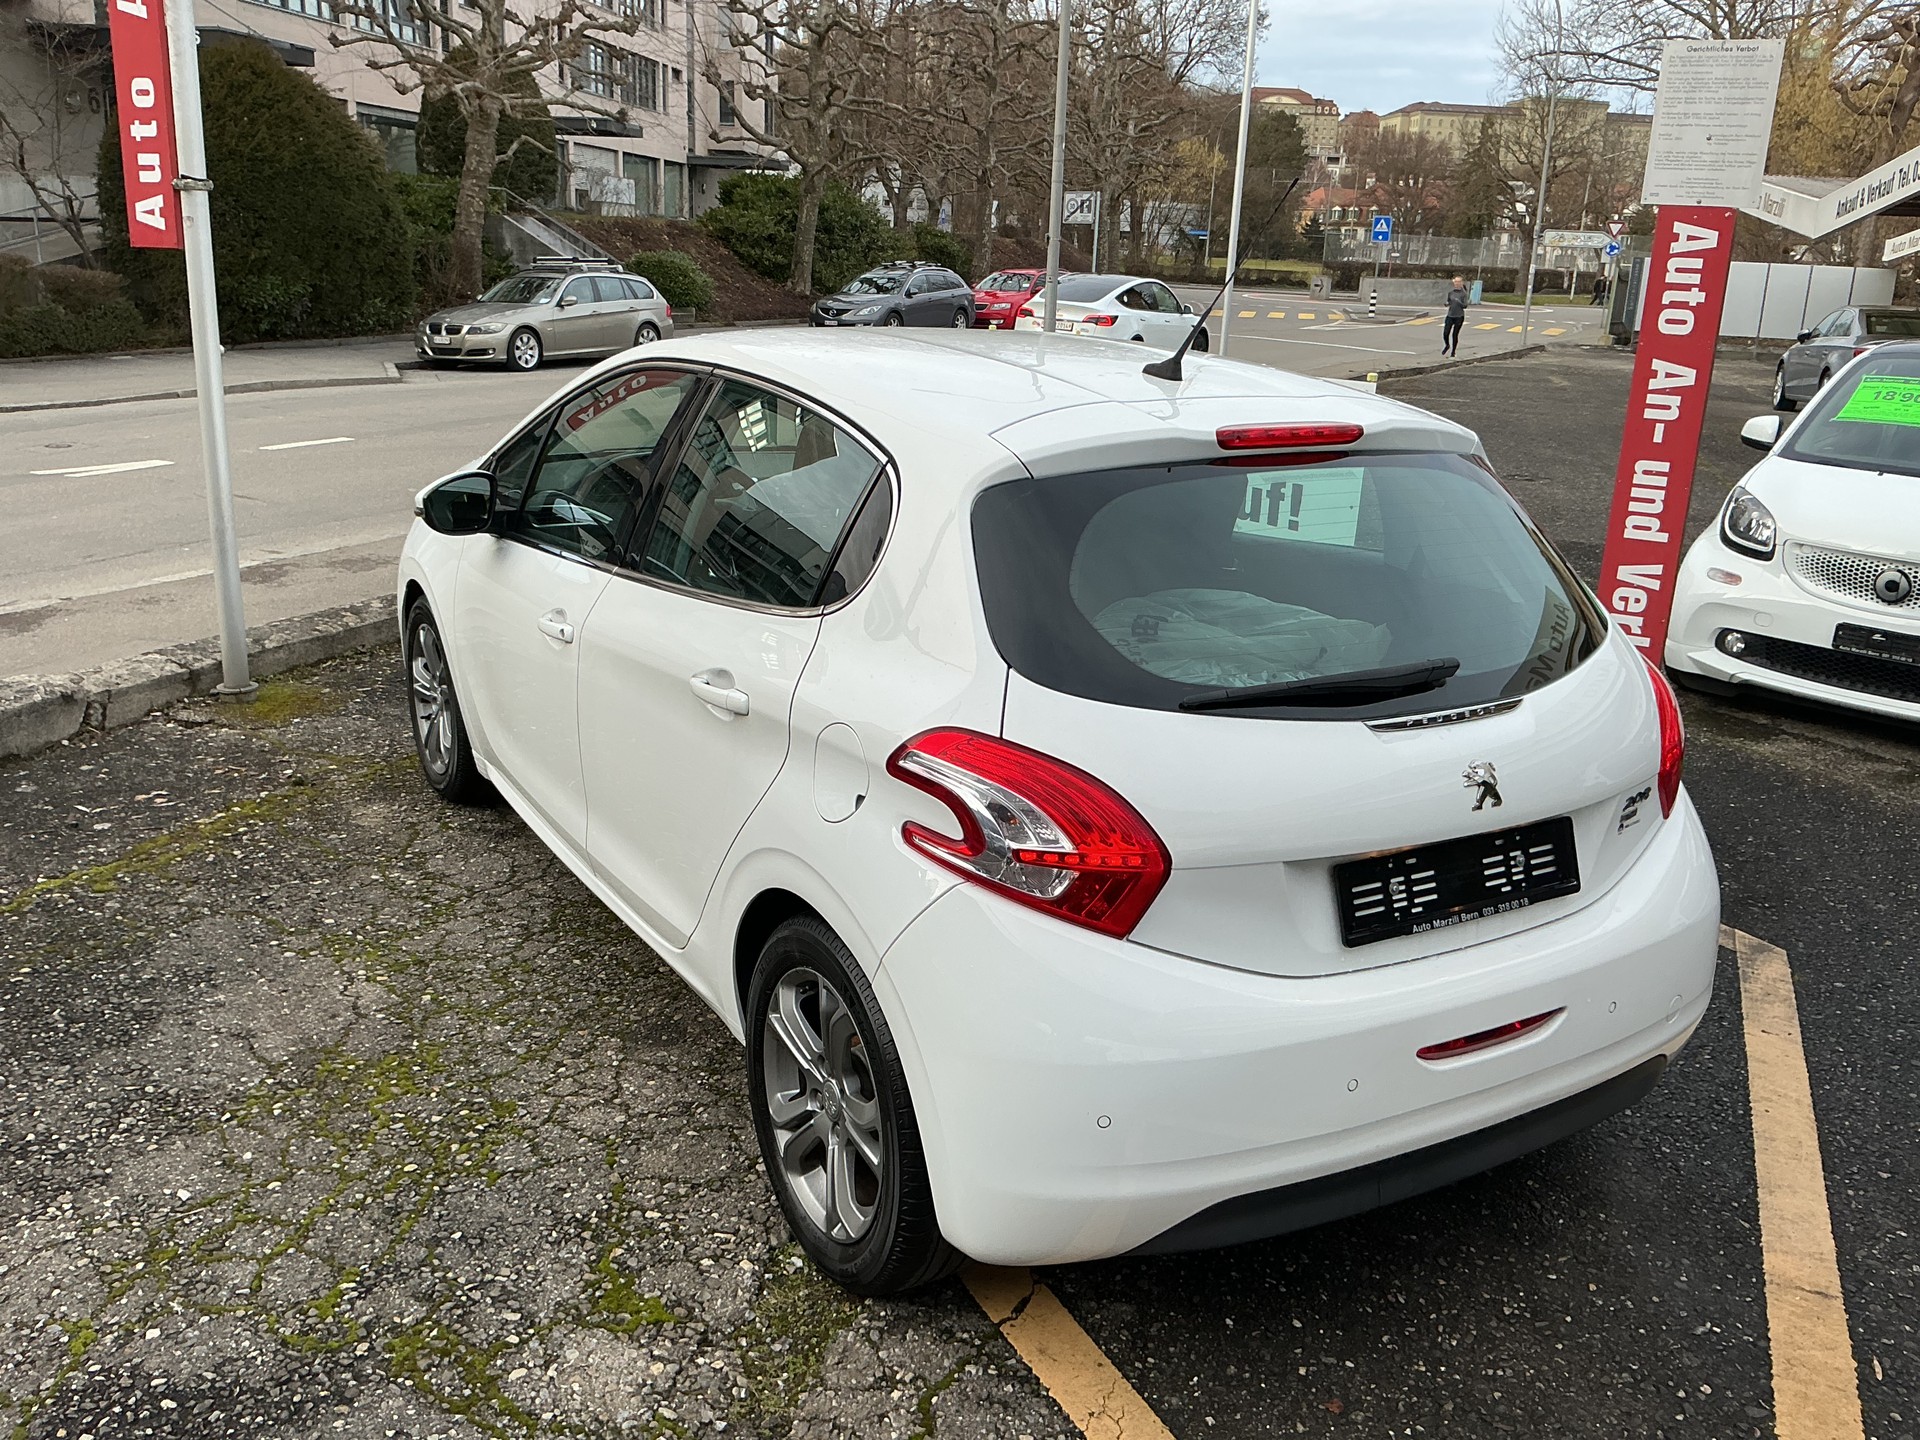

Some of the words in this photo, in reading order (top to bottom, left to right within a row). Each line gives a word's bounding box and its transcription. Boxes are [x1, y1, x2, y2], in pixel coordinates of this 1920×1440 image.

[1686, 45, 1734, 53] Gerichtliches
[130, 77, 166, 231] Auto
[1836, 189, 1860, 219] Ankauf
[1859, 187, 1866, 208] &
[1866, 171, 1897, 205] Verkauf
[1897, 163, 1911, 190] Tel.
[1657, 221, 1720, 336] Auto
[1643, 358, 1697, 443] An-
[1623, 459, 1671, 543] und
[1406, 705, 1496, 727] PEUGEOT
[1412, 922, 1431, 934] Auto
[1433, 914, 1460, 929] Marzili
[1461, 911, 1480, 922] Bern
